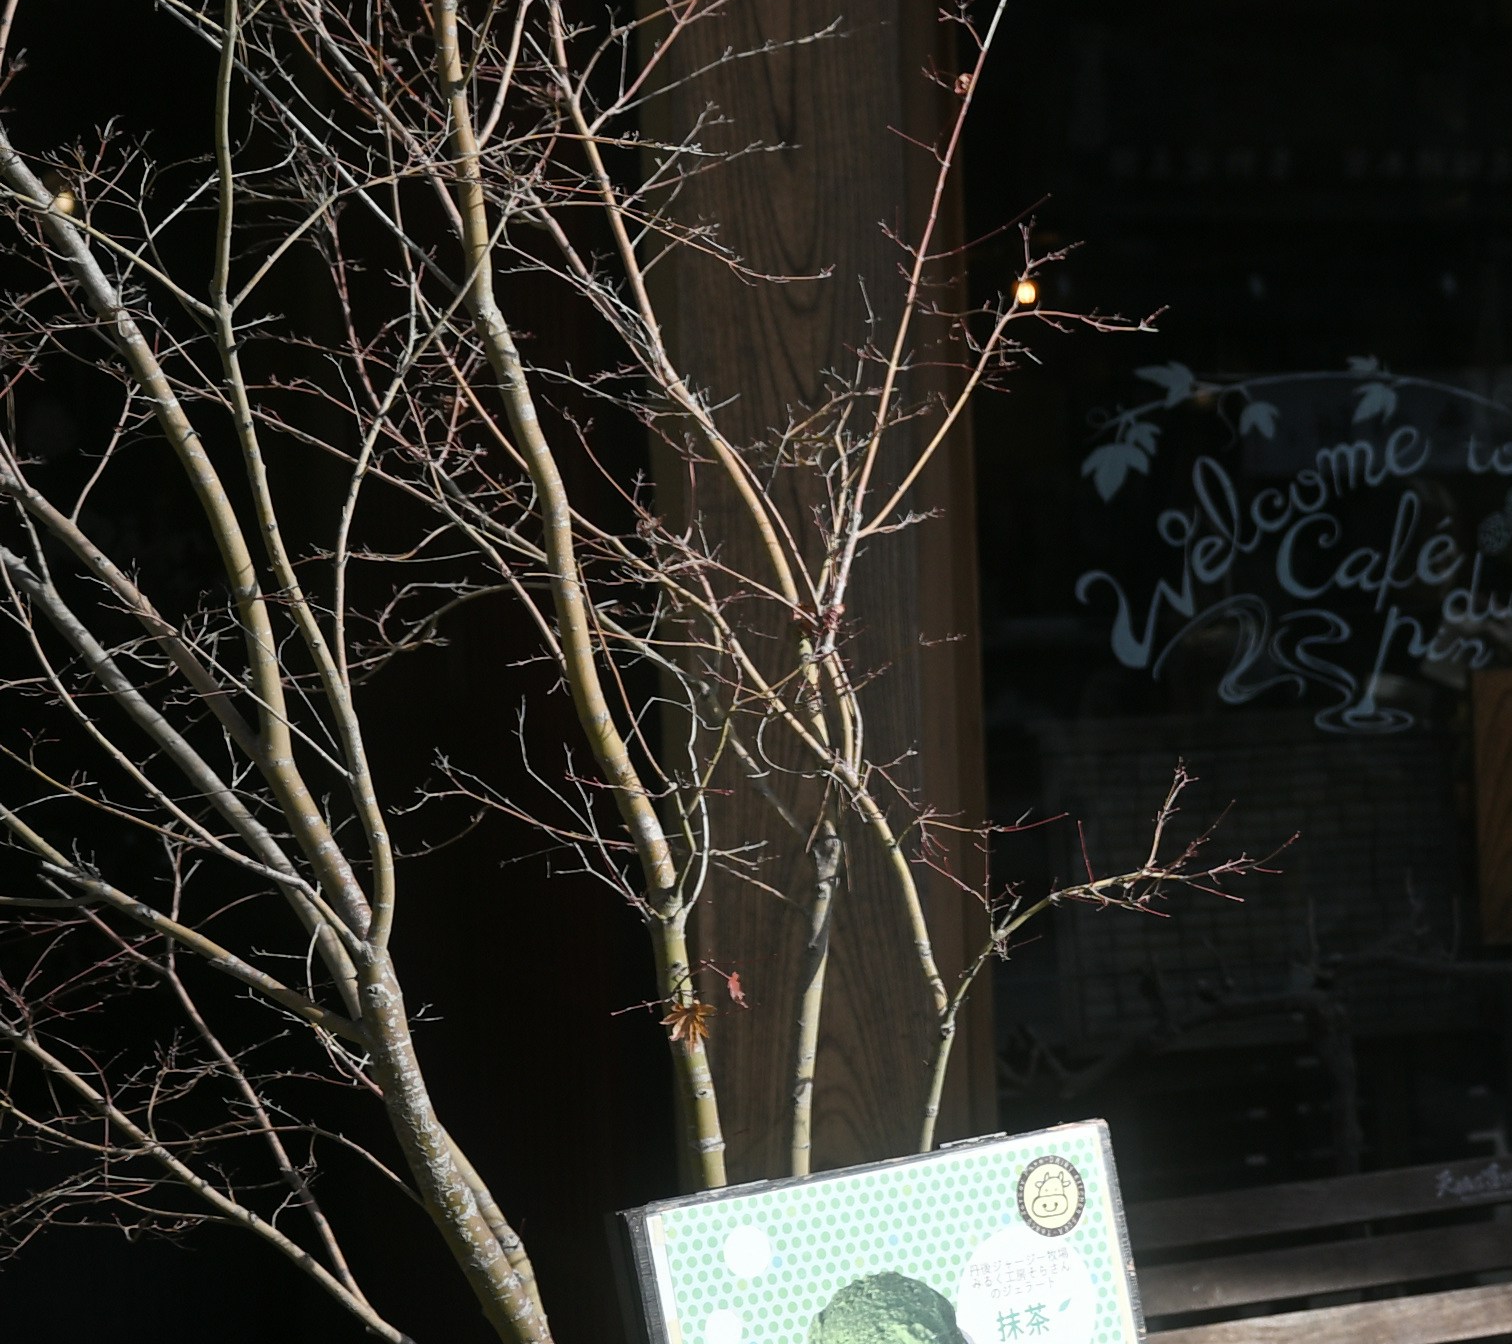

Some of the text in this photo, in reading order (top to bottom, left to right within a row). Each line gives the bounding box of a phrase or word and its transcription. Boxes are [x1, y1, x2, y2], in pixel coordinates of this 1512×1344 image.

[1075, 425, 1429, 669] Welcome
[1276, 490, 1455, 613] Café
[996, 1303, 1050, 1342] 抹茶
